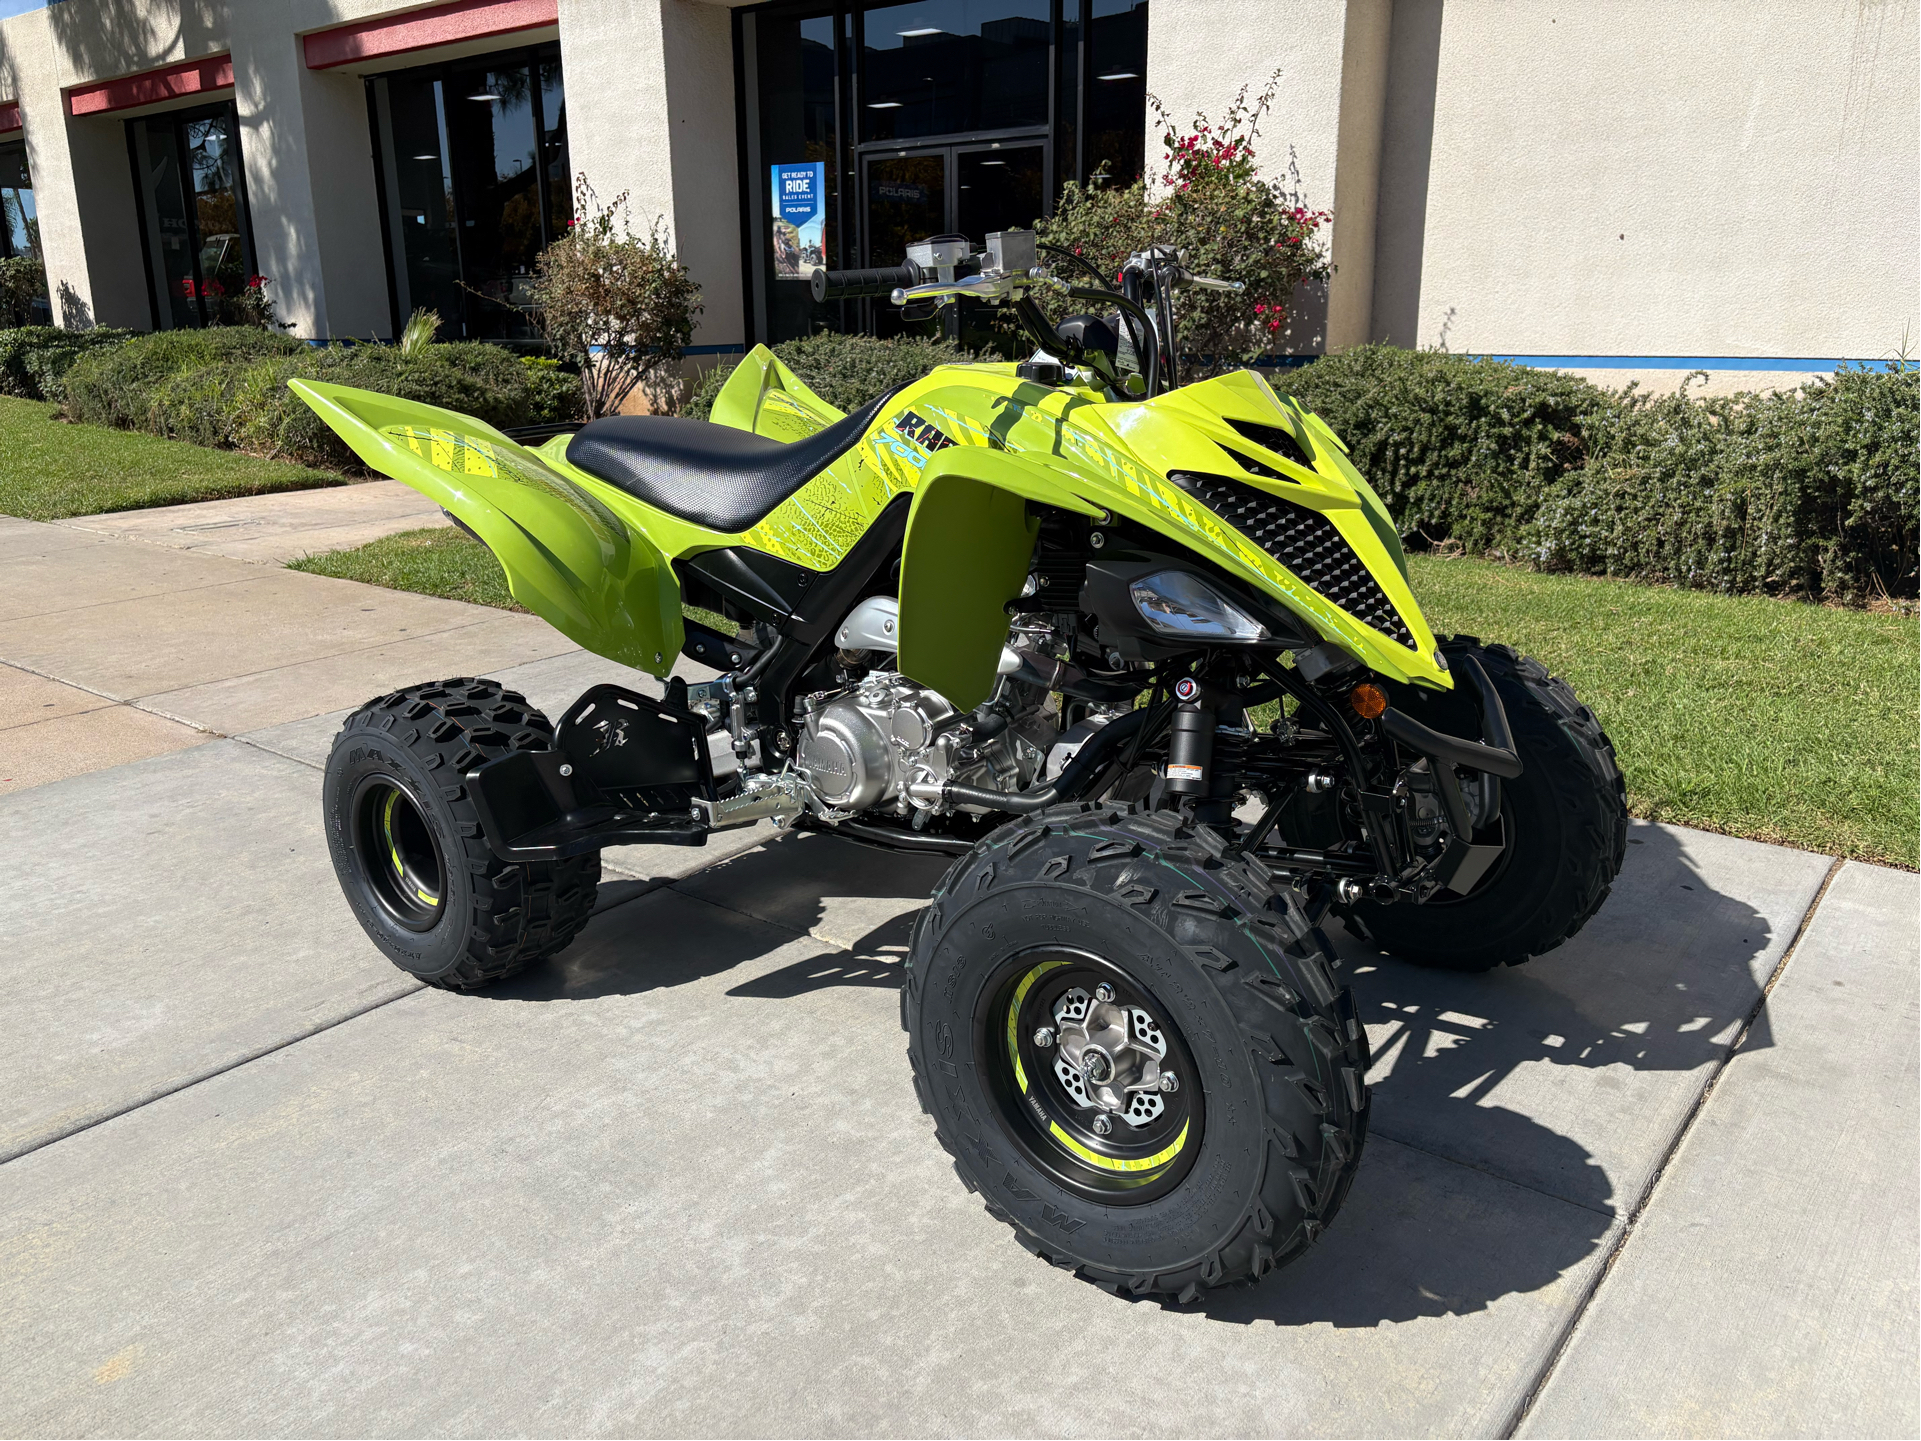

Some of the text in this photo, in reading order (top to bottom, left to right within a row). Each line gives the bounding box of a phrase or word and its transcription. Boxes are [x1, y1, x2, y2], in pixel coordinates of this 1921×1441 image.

[791, 171, 807, 179] READY
[785, 179, 810, 194] RIDE
[878, 186, 921, 199] POLARIS
[807, 756, 848, 777] YAMAHA
[348, 747, 446, 840] MAXXIS
[1028, 1095, 1048, 1122] YAMAHA
[935, 1019, 1088, 1236] MAXXIS
